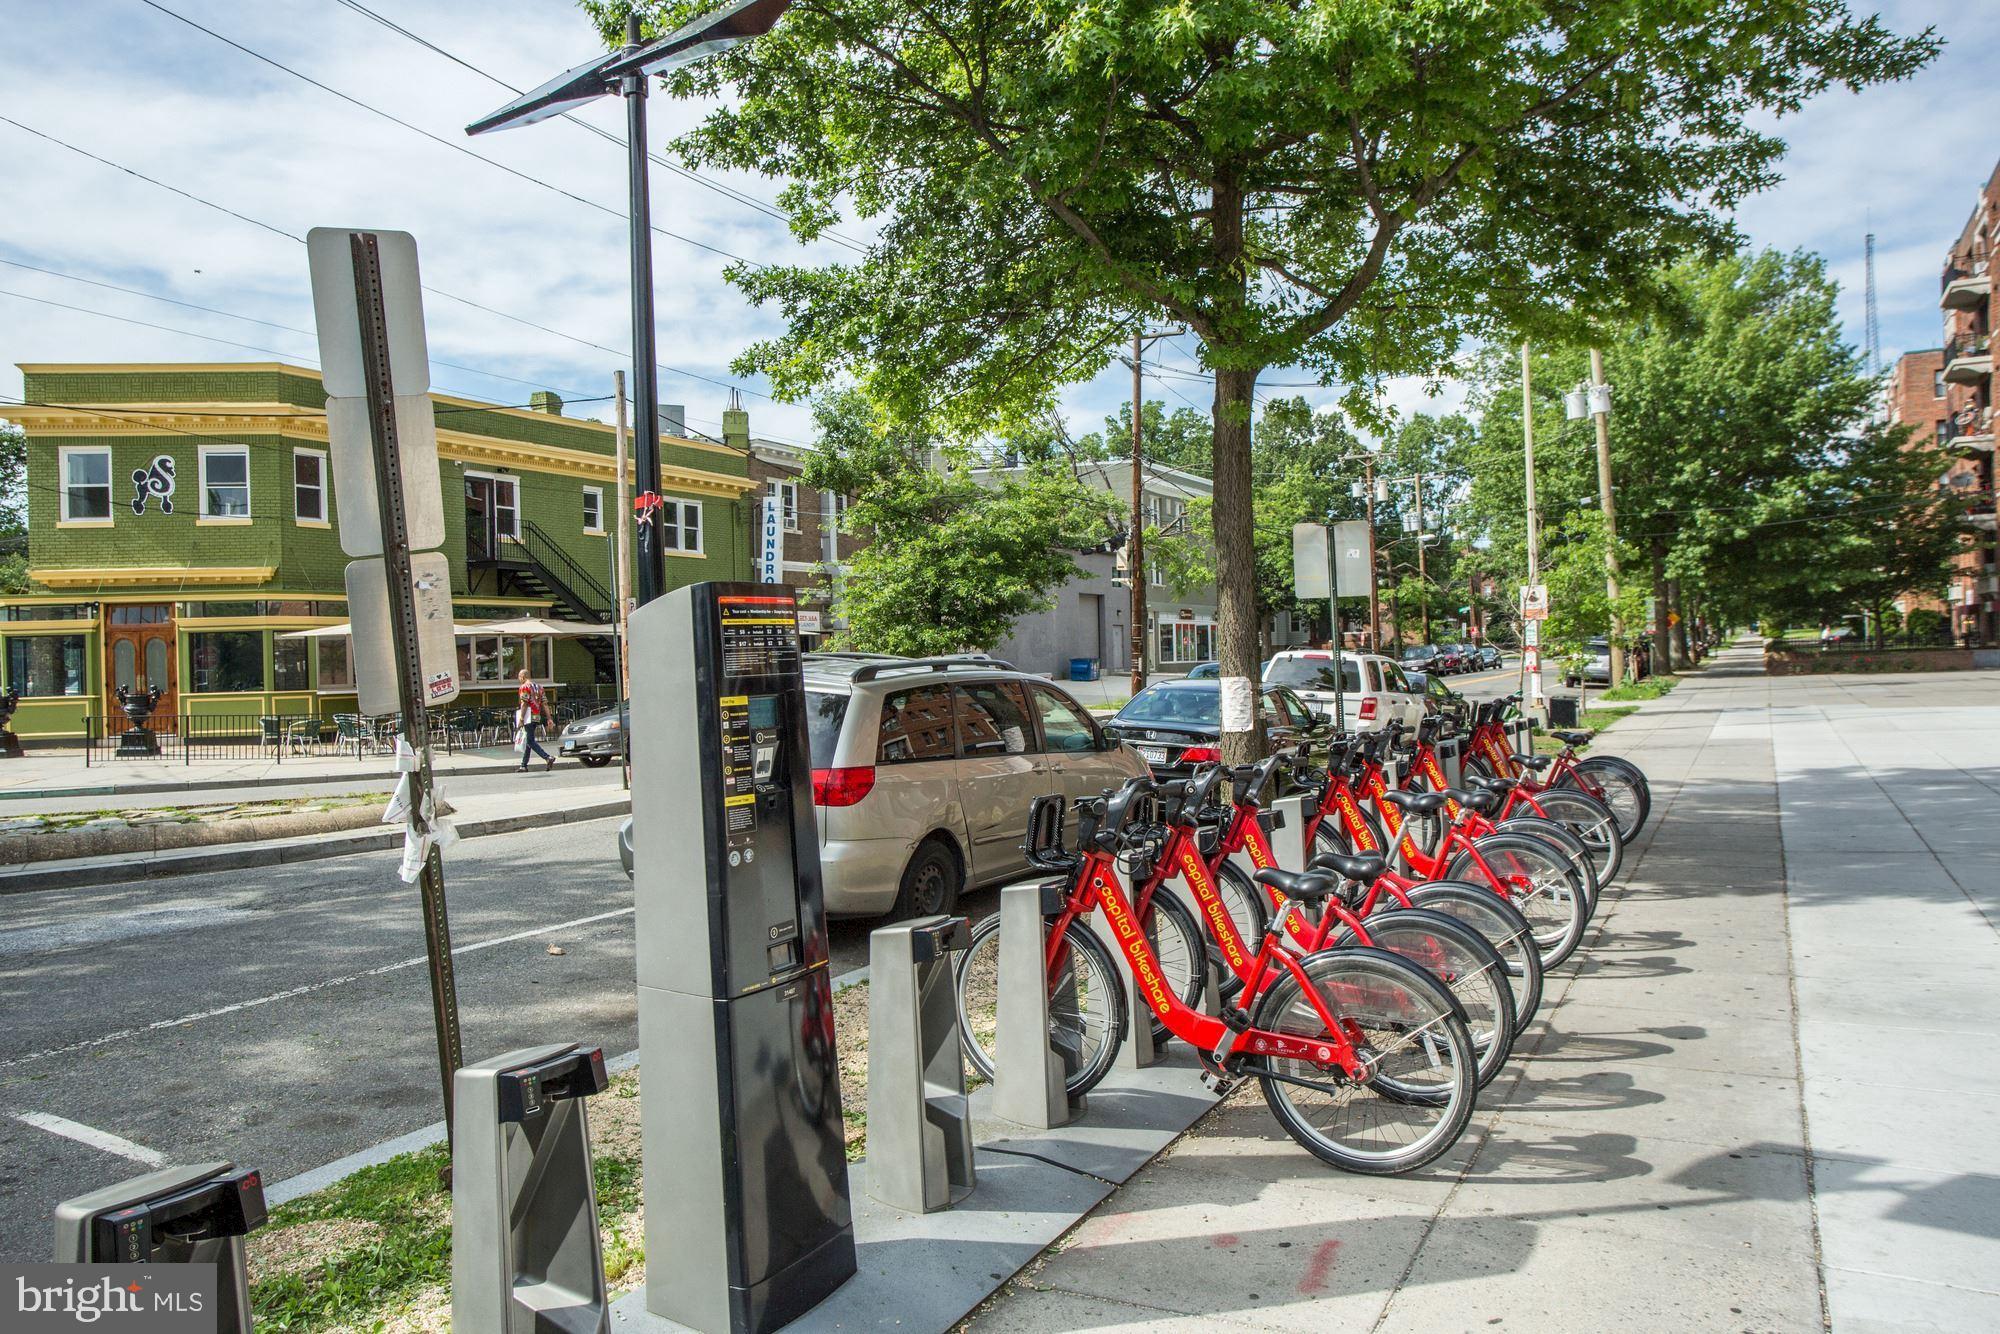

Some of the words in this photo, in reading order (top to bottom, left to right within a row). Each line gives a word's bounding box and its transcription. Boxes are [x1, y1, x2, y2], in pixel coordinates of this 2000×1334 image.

[1427, 762, 1446, 788] capital
[1341, 796, 1364, 830] capital
[1183, 854, 1215, 902] capital
[1207, 900, 1243, 967] bikeshare
[1101, 885, 1137, 939] capital
[1129, 939, 1170, 1014] bikeshare
